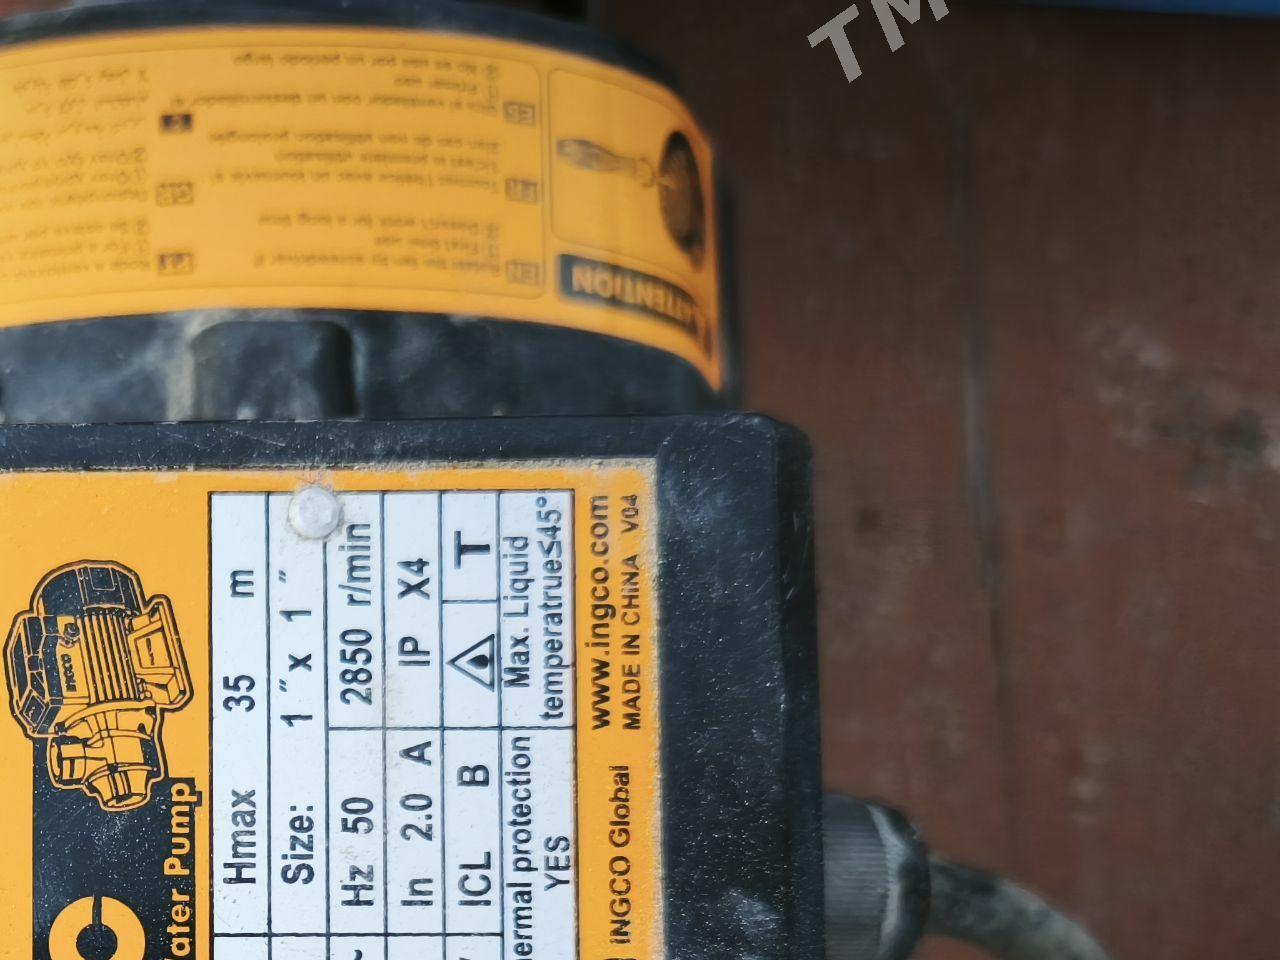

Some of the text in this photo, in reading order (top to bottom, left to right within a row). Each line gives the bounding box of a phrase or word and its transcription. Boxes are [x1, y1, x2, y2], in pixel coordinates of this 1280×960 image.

[396, 557, 431, 667] IP X4
[453, 530, 491, 570] T
[501, 535, 536, 689] Max. Liquid
[620, 493, 642, 731] MADE IN CHINA V04
[338, 522, 373, 706] 2850 r/min
[584, 495, 616, 731] www.ingco.com
[222, 569, 258, 885] Hmax 35 m
[398, 740, 432, 767] A
[164, 781, 198, 877] Pump
[280, 804, 315, 885] Size:
[340, 797, 375, 907] Hz 50
[399, 793, 433, 841] 2.0
[456, 764, 492, 907] ICL B
[503, 736, 538, 874] protection
[543, 835, 571, 891] YES
[608, 765, 632, 945] INGCO Global
